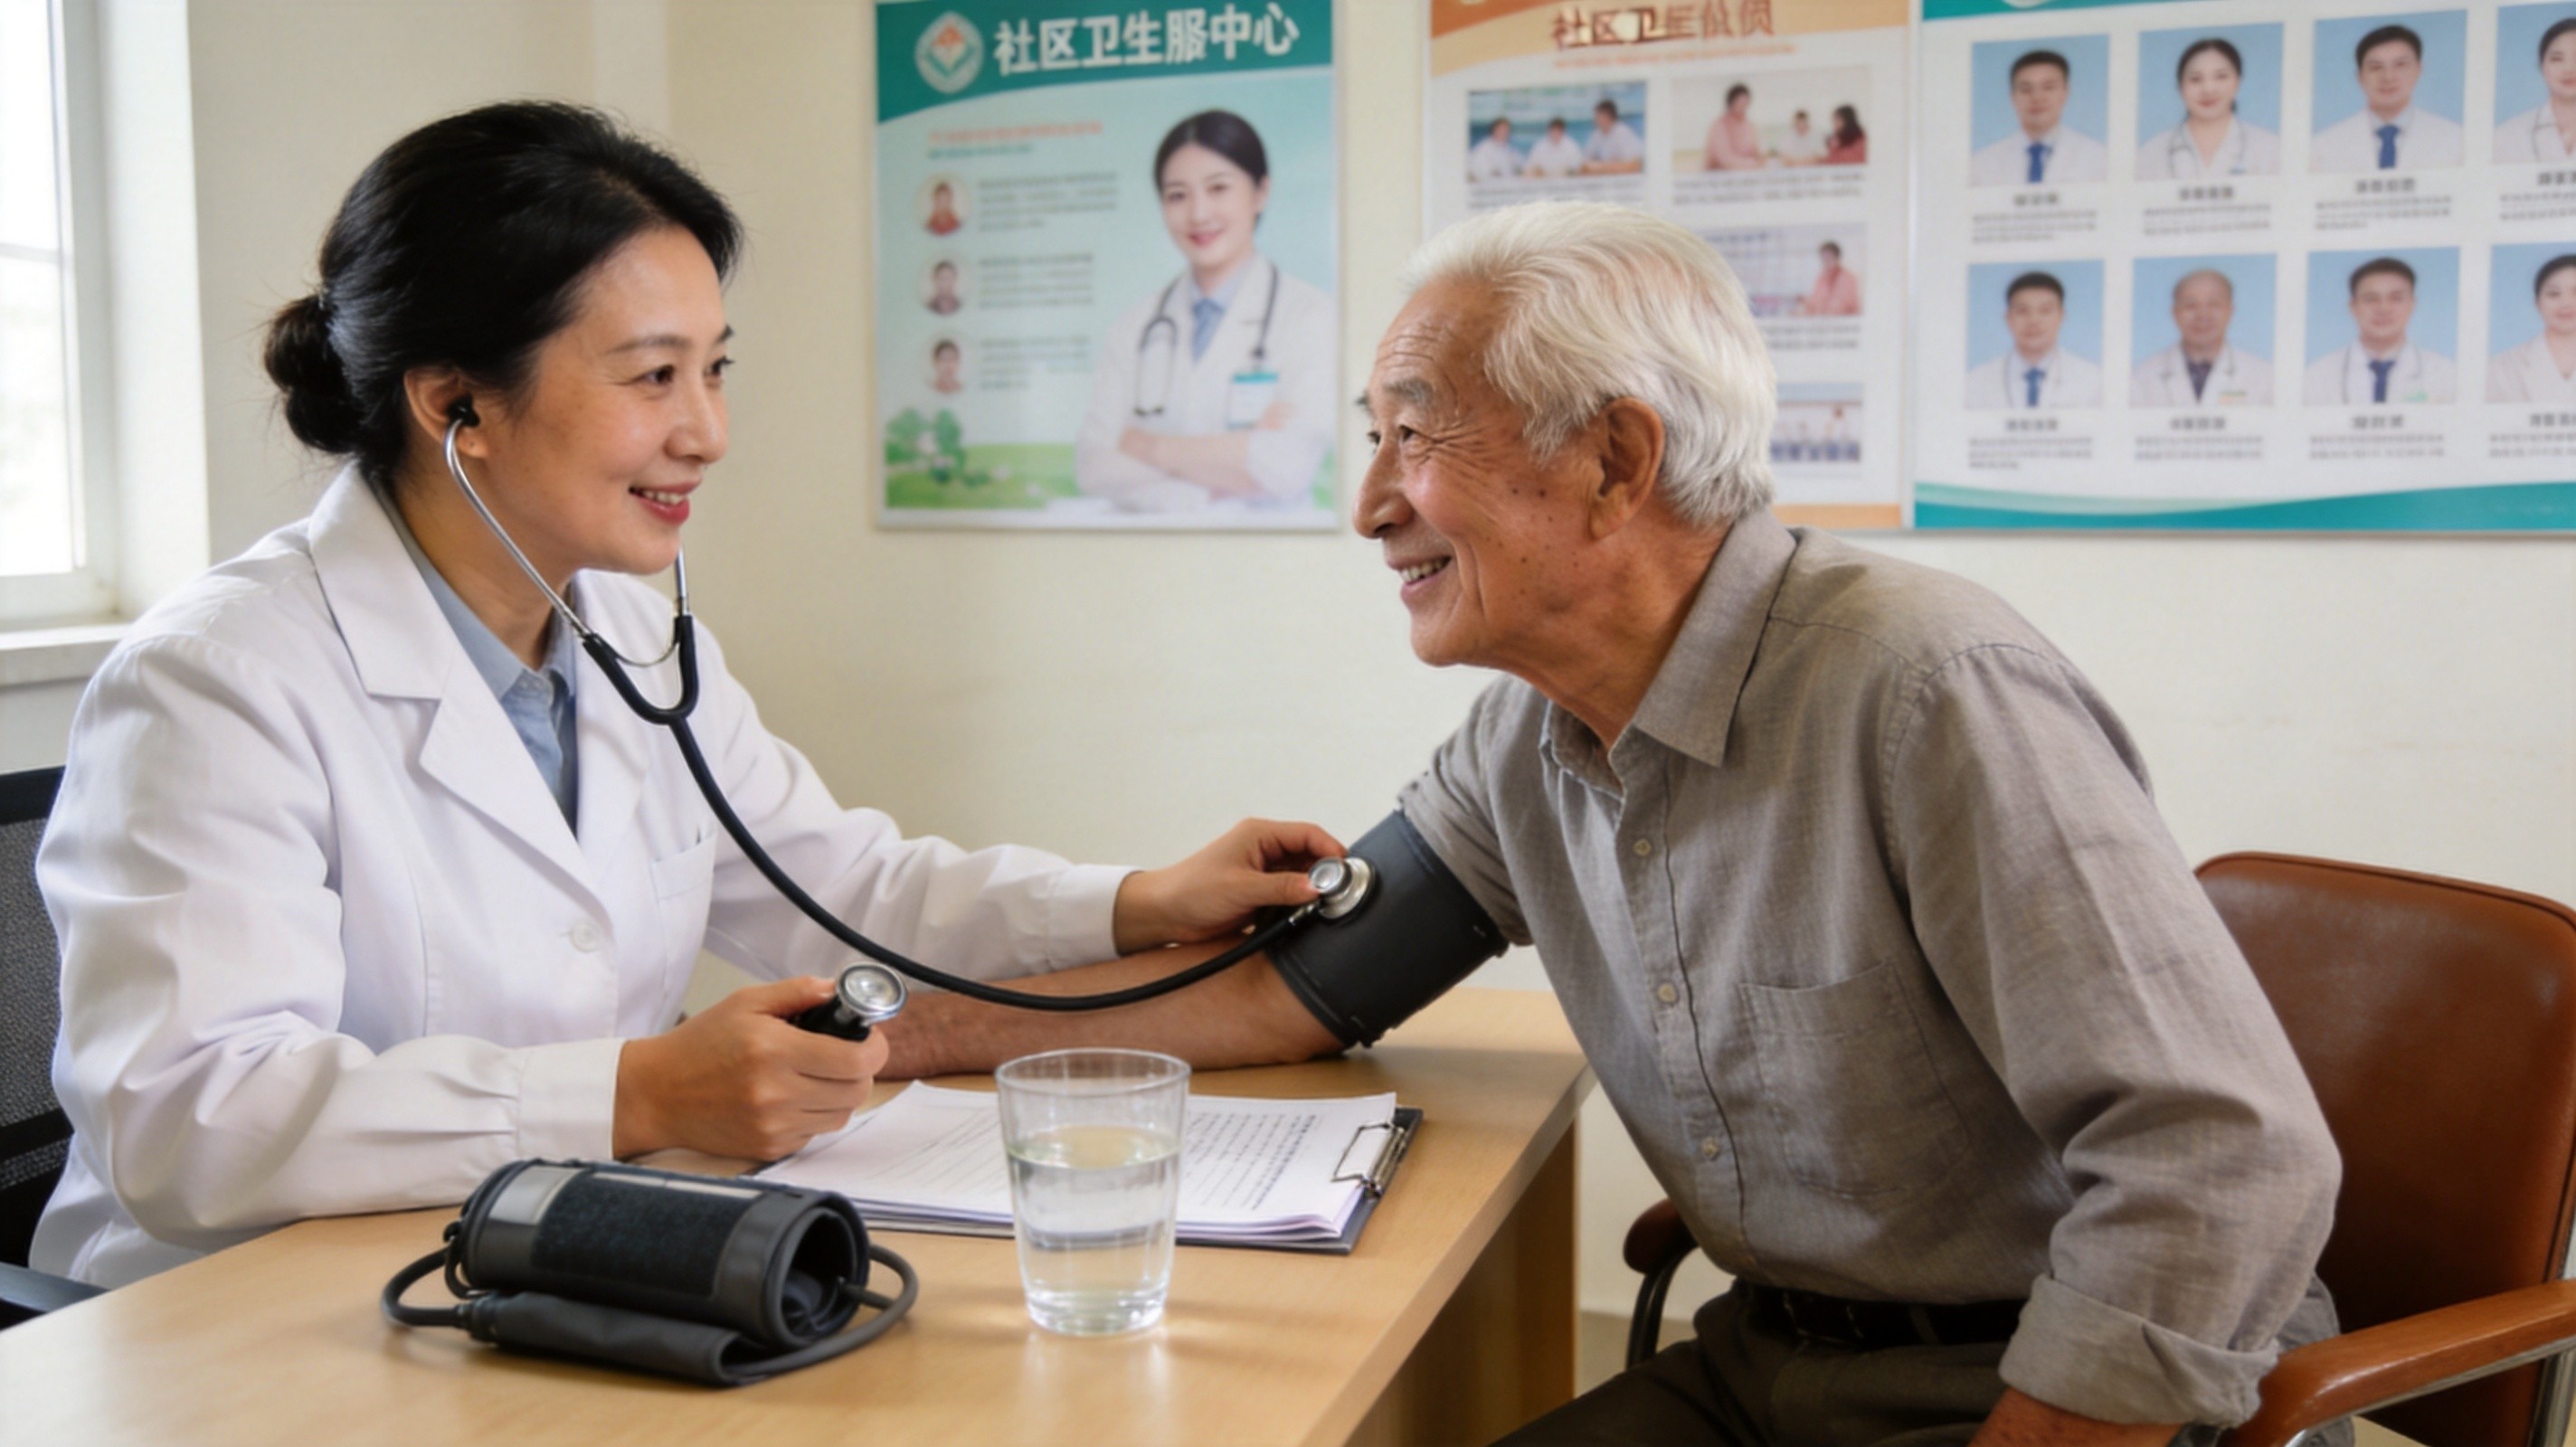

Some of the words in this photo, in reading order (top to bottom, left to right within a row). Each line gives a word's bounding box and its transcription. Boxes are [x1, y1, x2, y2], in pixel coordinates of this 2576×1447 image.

[993, 2, 1300, 76] 社区卫生服中心
